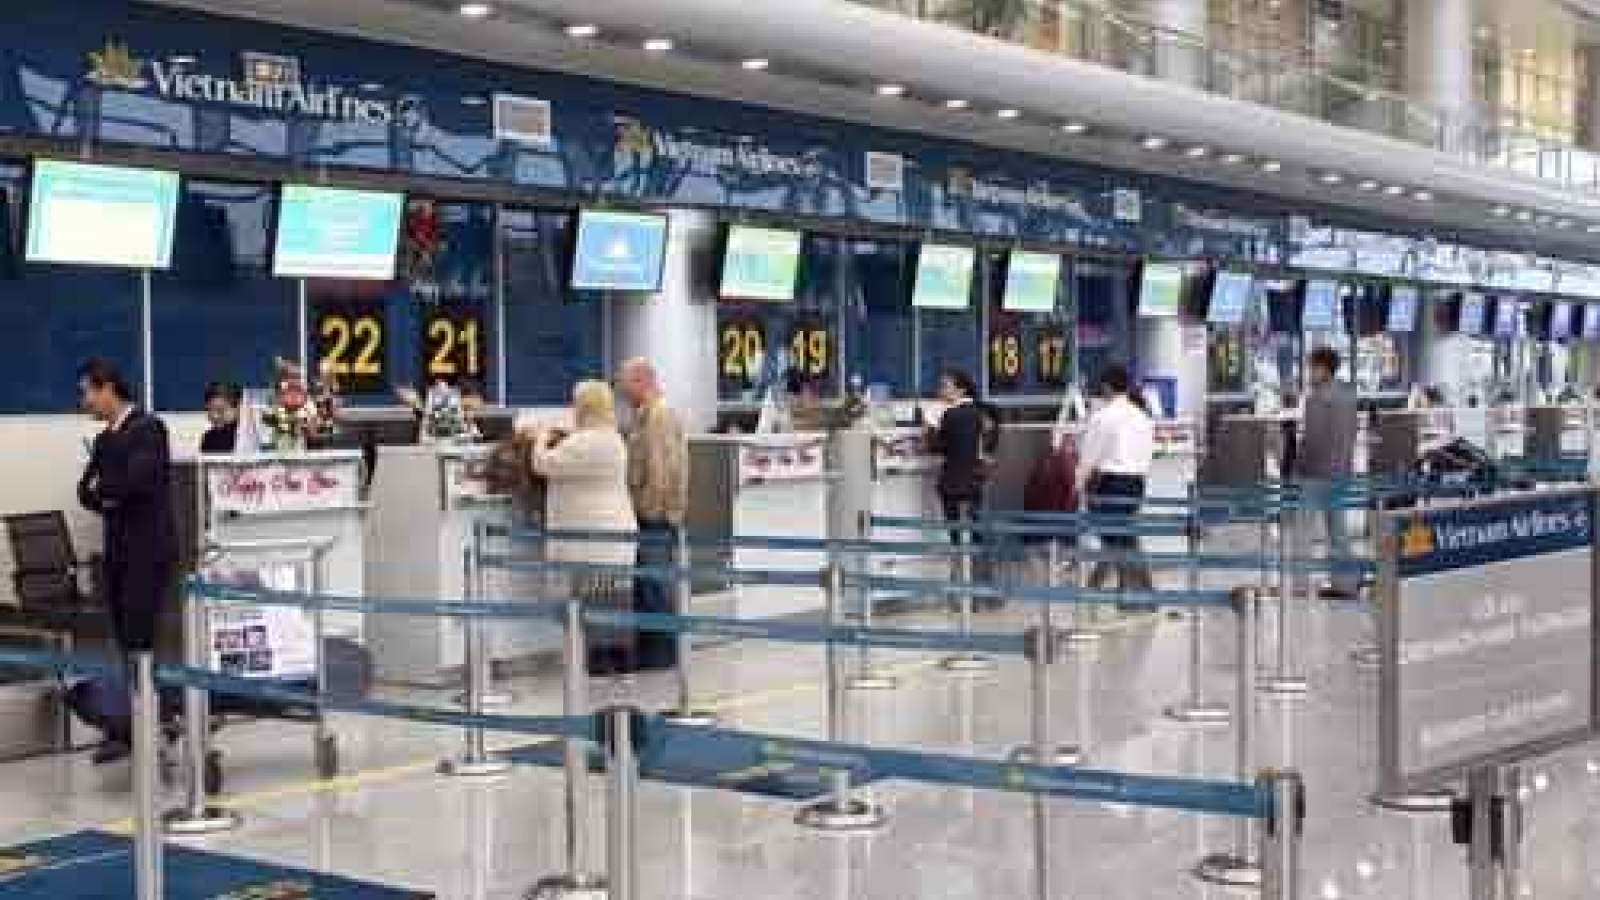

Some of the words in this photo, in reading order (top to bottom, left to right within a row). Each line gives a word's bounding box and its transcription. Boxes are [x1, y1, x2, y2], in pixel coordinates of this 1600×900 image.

[320, 315, 382, 374] 22
[428, 317, 479, 374] 21
[722, 326, 762, 374] 20
[793, 330, 827, 374] 19
[991, 336, 1019, 376] 18
